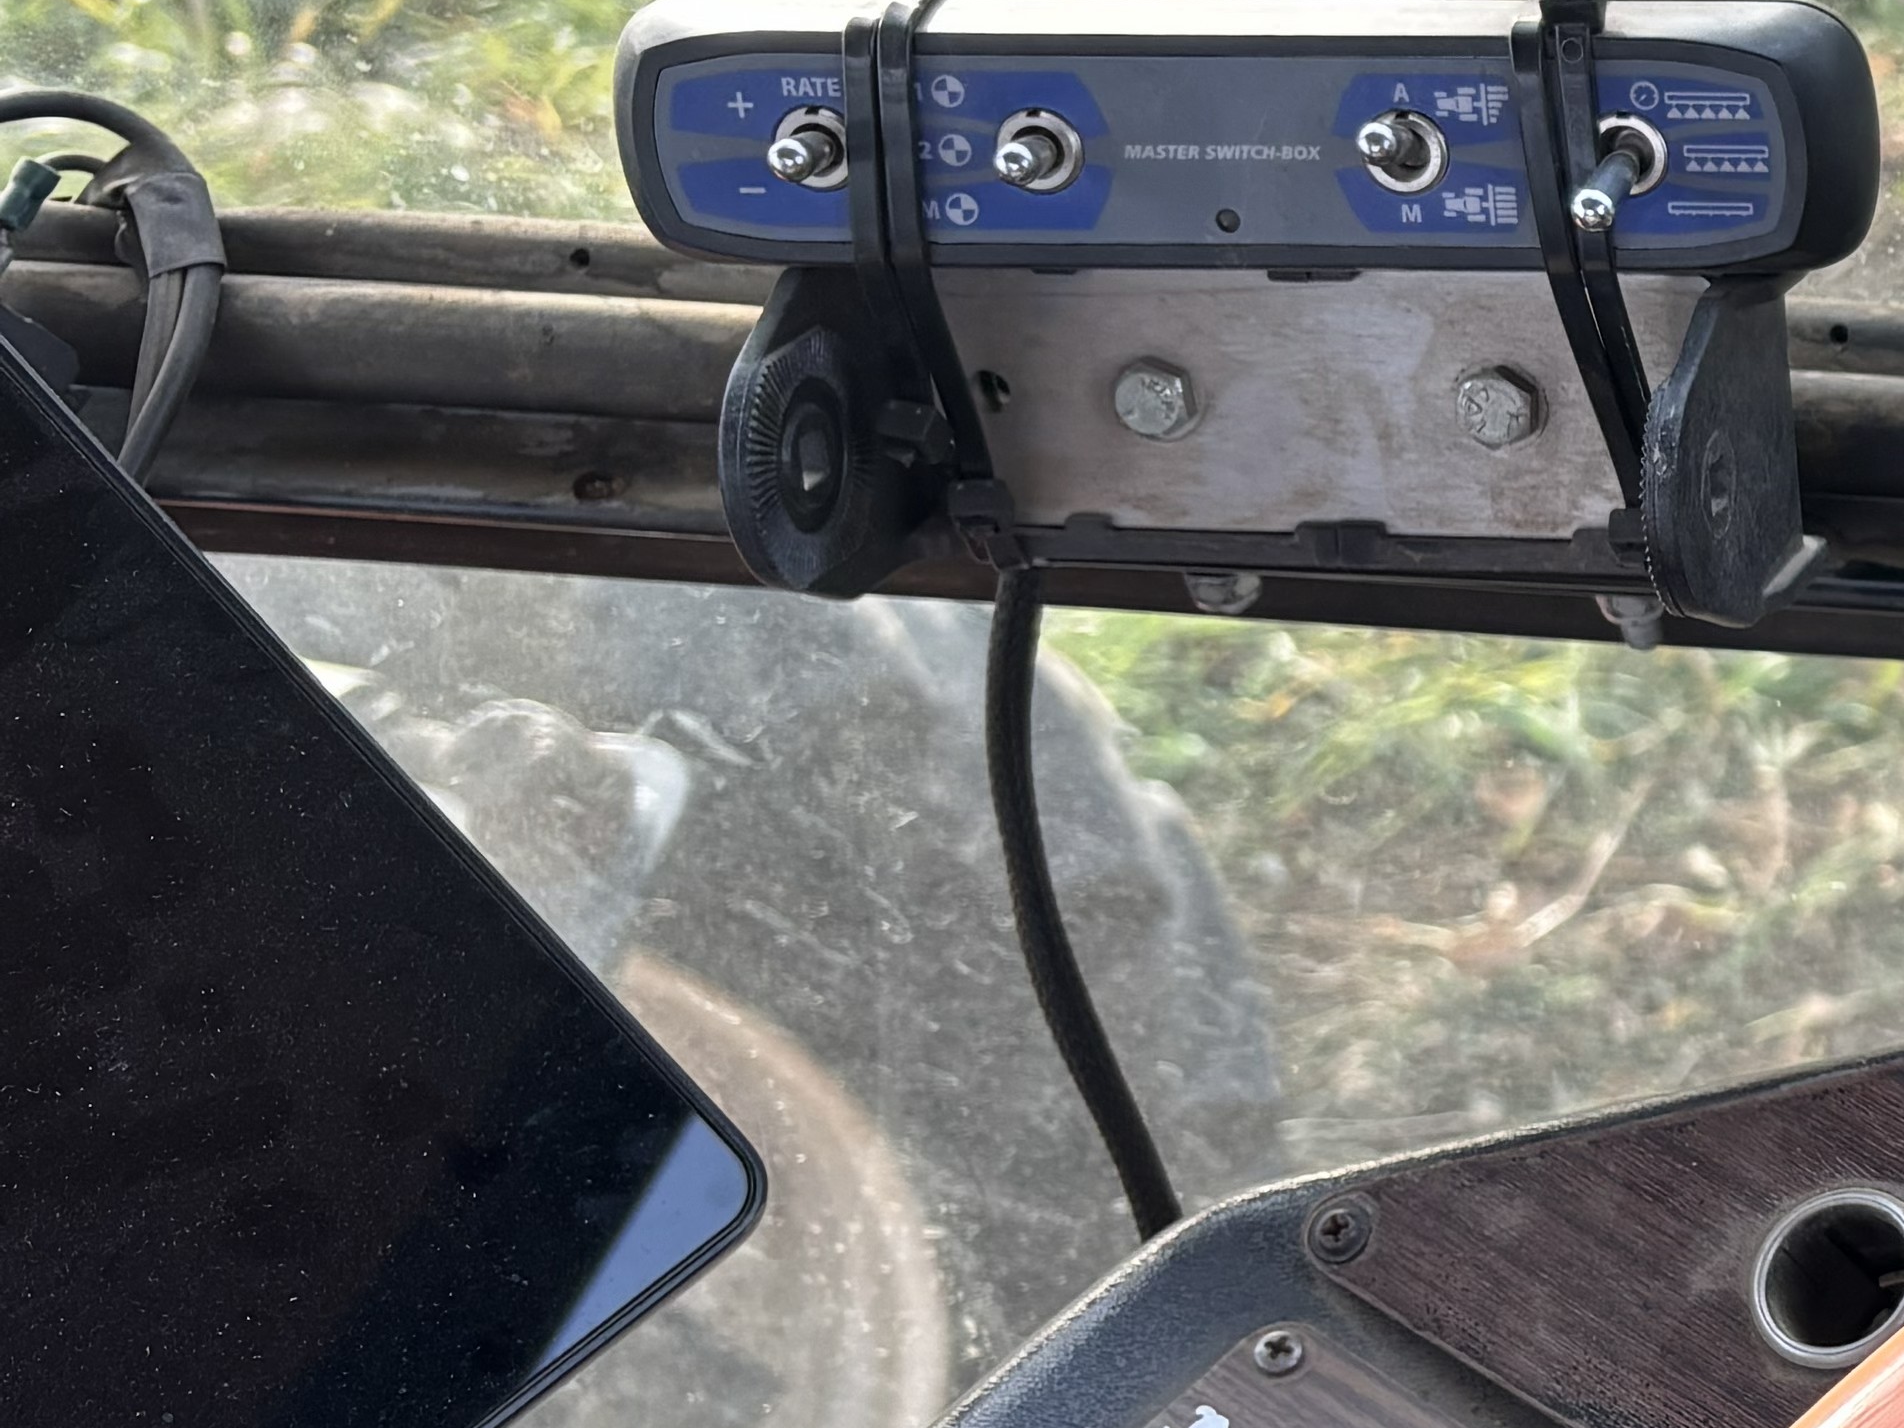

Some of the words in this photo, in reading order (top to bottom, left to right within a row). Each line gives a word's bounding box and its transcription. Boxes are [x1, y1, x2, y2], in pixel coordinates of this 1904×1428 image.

[781, 77, 841, 98] RATE
[913, 82, 923, 101] 1
[1393, 83, 1409, 103] A
[917, 141, 934, 160] 2
[1124, 145, 1199, 160] MASTER
[1204, 145, 1320, 160] SWITCH-BOX
[922, 200, 941, 220] M
[1402, 204, 1422, 224] M
